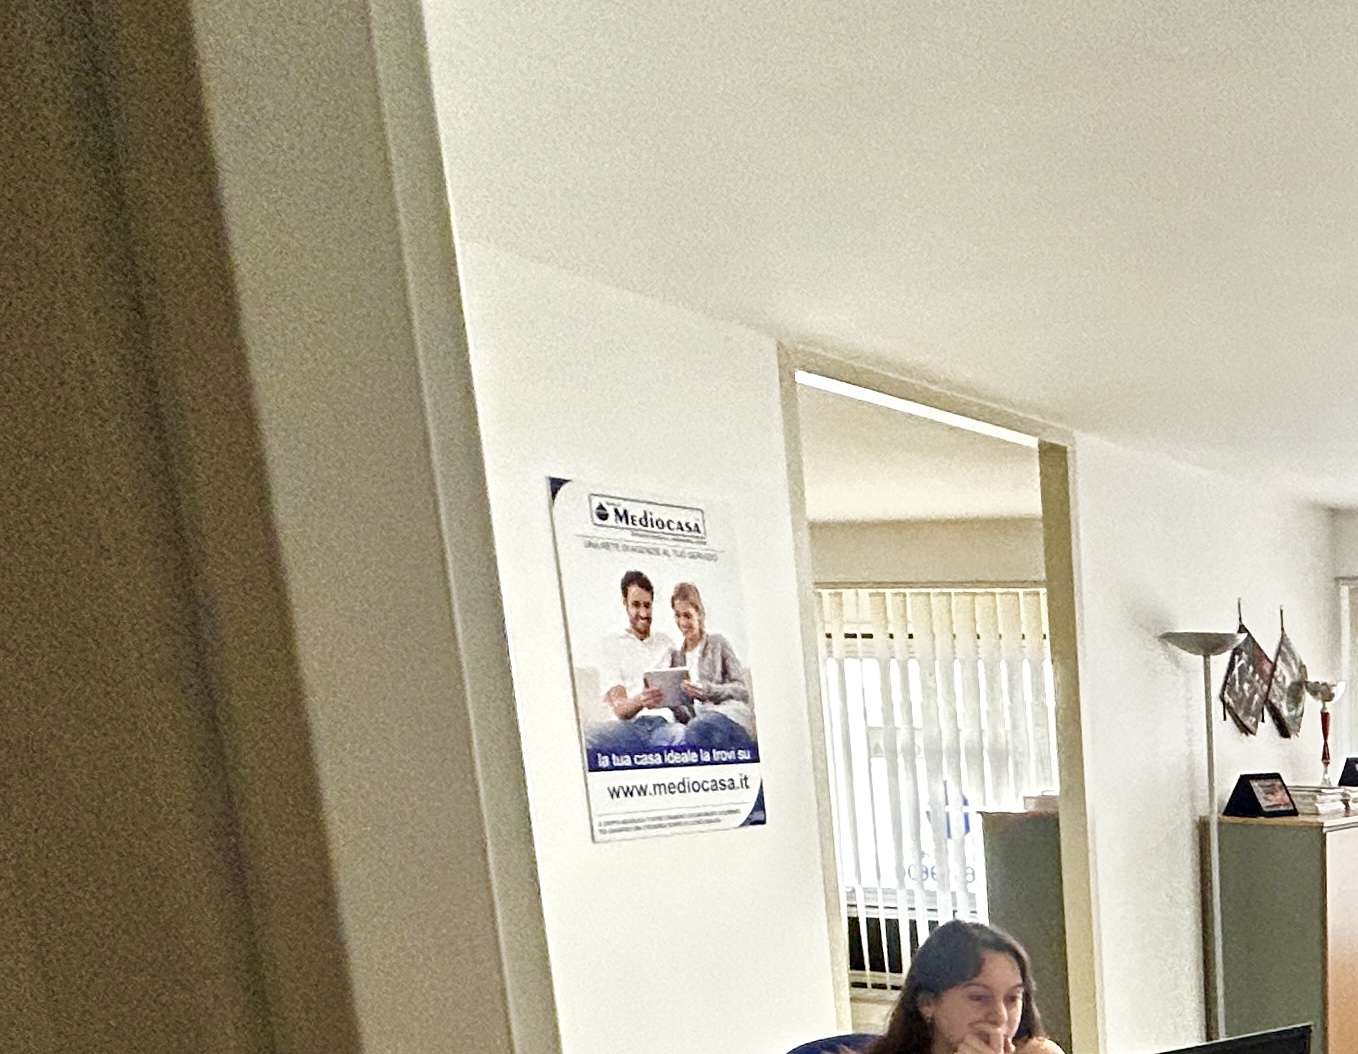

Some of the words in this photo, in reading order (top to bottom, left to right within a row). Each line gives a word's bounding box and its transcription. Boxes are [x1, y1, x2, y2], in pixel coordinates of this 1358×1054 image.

[597, 752, 610, 768] la
[611, 753, 632, 767] tua
[633, 753, 663, 766] casa
[663, 749, 698, 764] ideale
[699, 749, 711, 762] la
[711, 748, 736, 761] trovi
[737, 749, 751, 760] su
[607, 773, 751, 800] www.mediocasa.it
